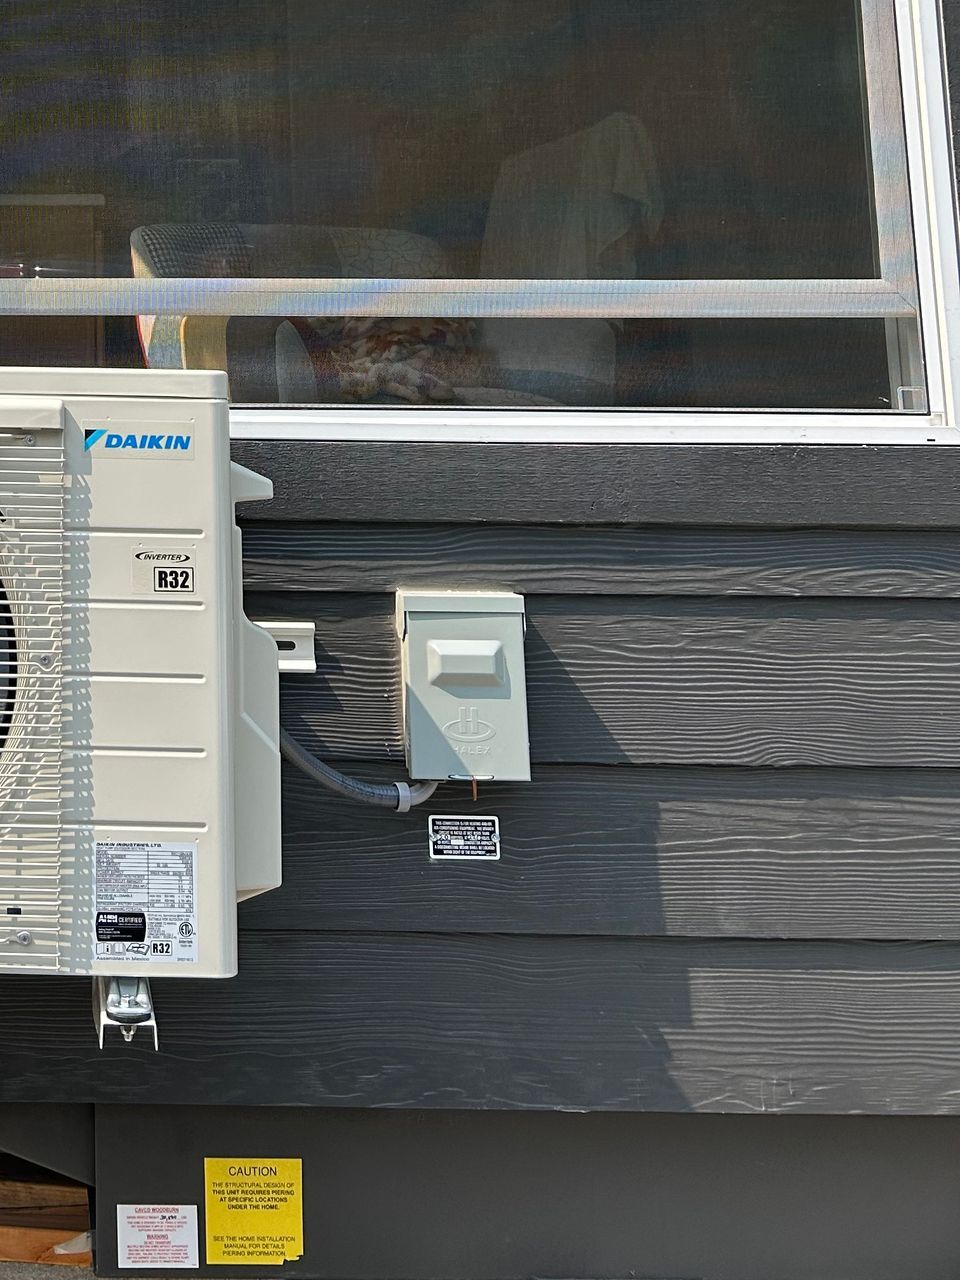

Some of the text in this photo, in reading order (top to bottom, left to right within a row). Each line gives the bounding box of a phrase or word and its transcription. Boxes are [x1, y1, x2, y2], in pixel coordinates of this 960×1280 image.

[104, 434, 190, 450] DAIKIN
[158, 571, 190, 589] R32
[452, 745, 490, 754] HALEX
[152, 943, 170, 953] R32
[228, 1166, 277, 1176] CAUTION
